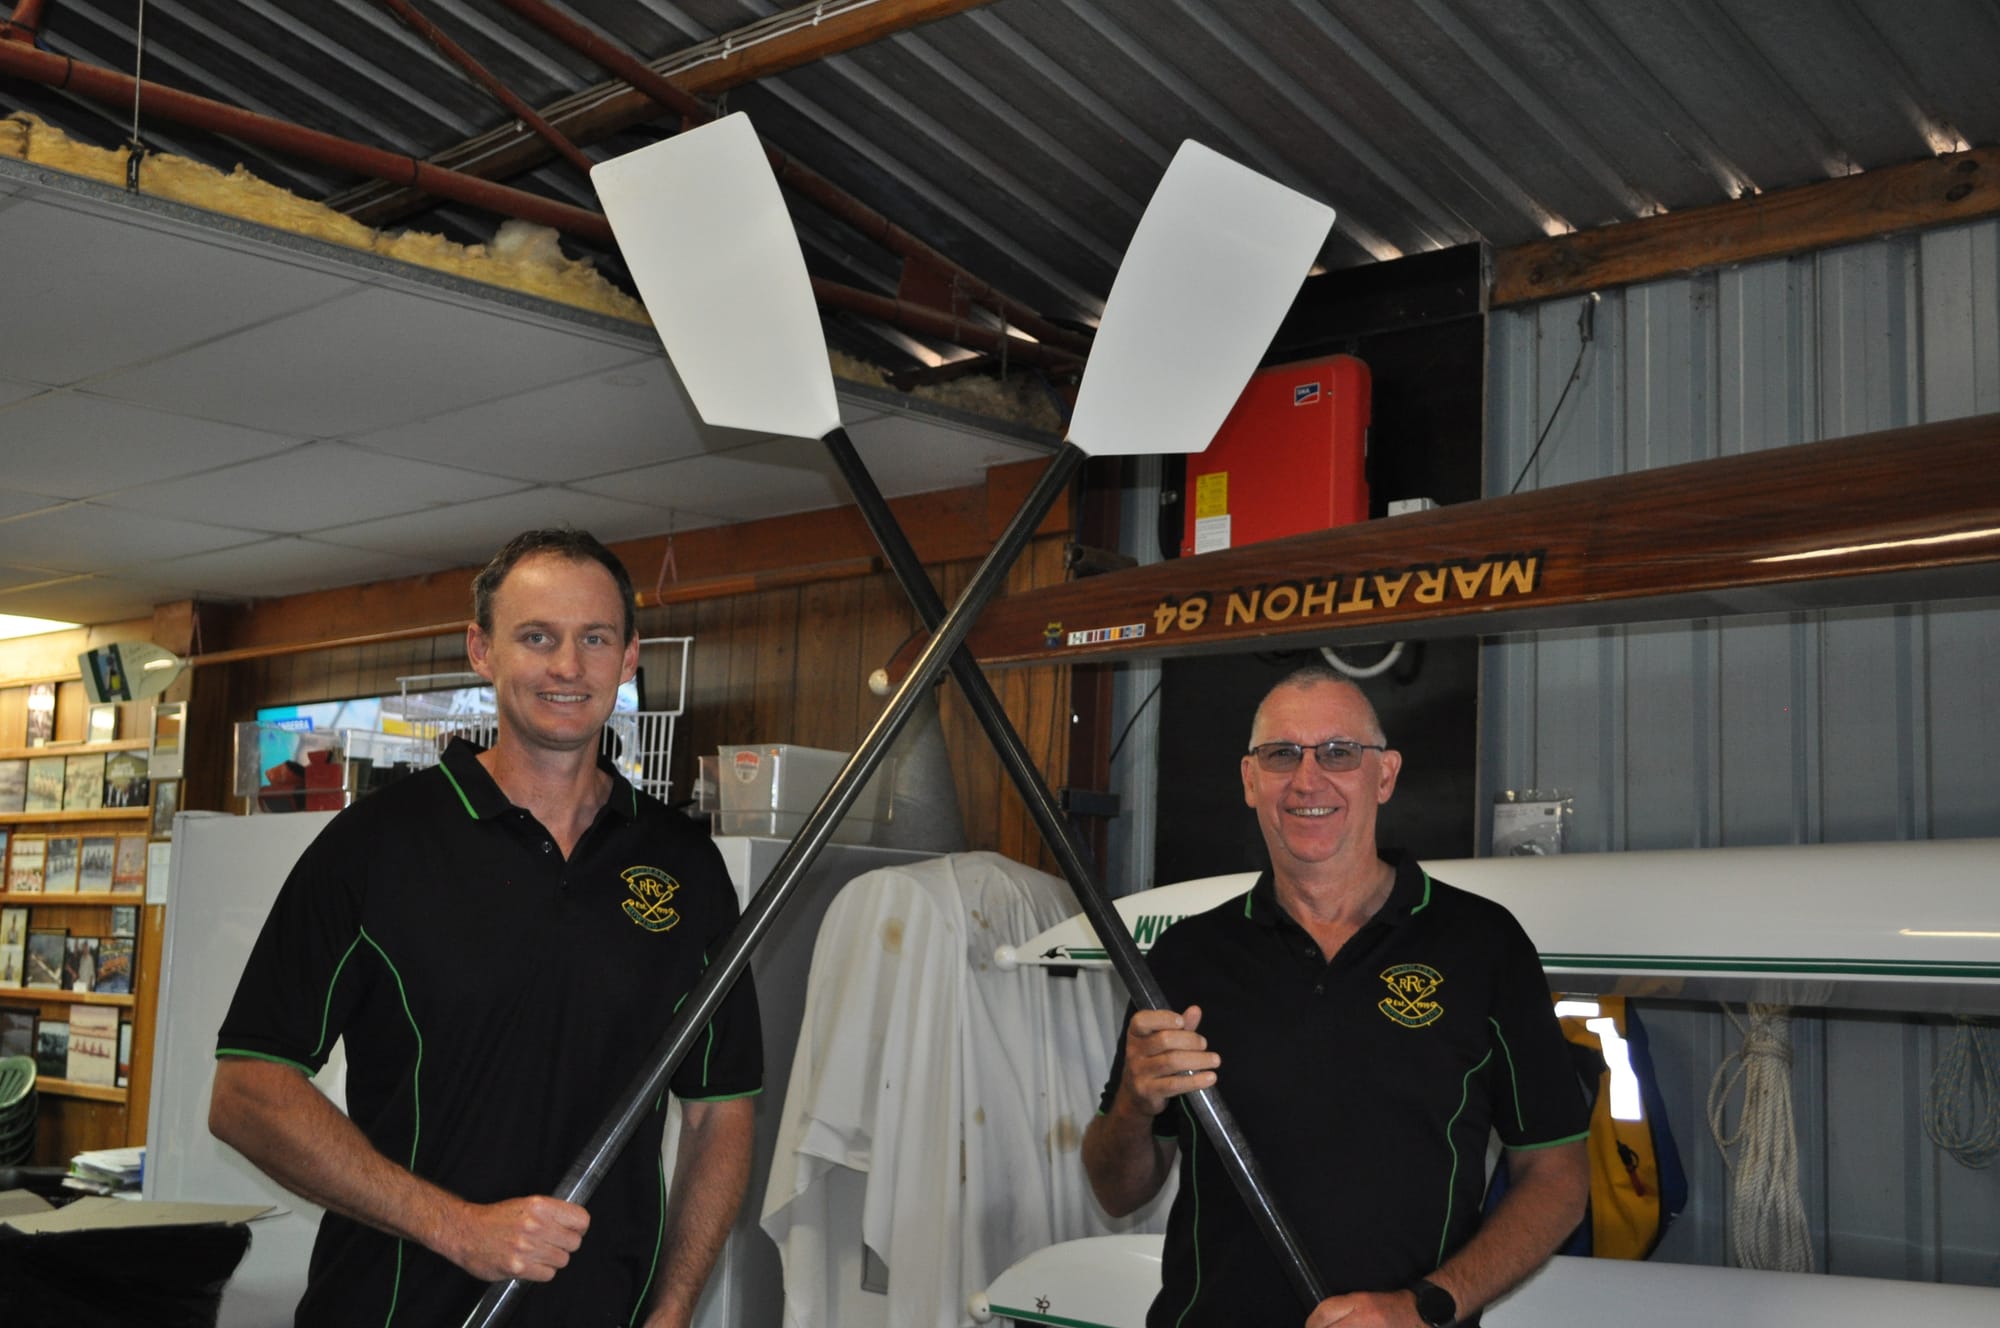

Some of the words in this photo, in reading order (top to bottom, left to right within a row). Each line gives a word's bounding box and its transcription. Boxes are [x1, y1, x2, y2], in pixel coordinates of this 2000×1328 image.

[1225, 557, 1537, 626] MARATHON
[1153, 597, 1208, 635] 84
[1399, 975, 1426, 992] RRC
